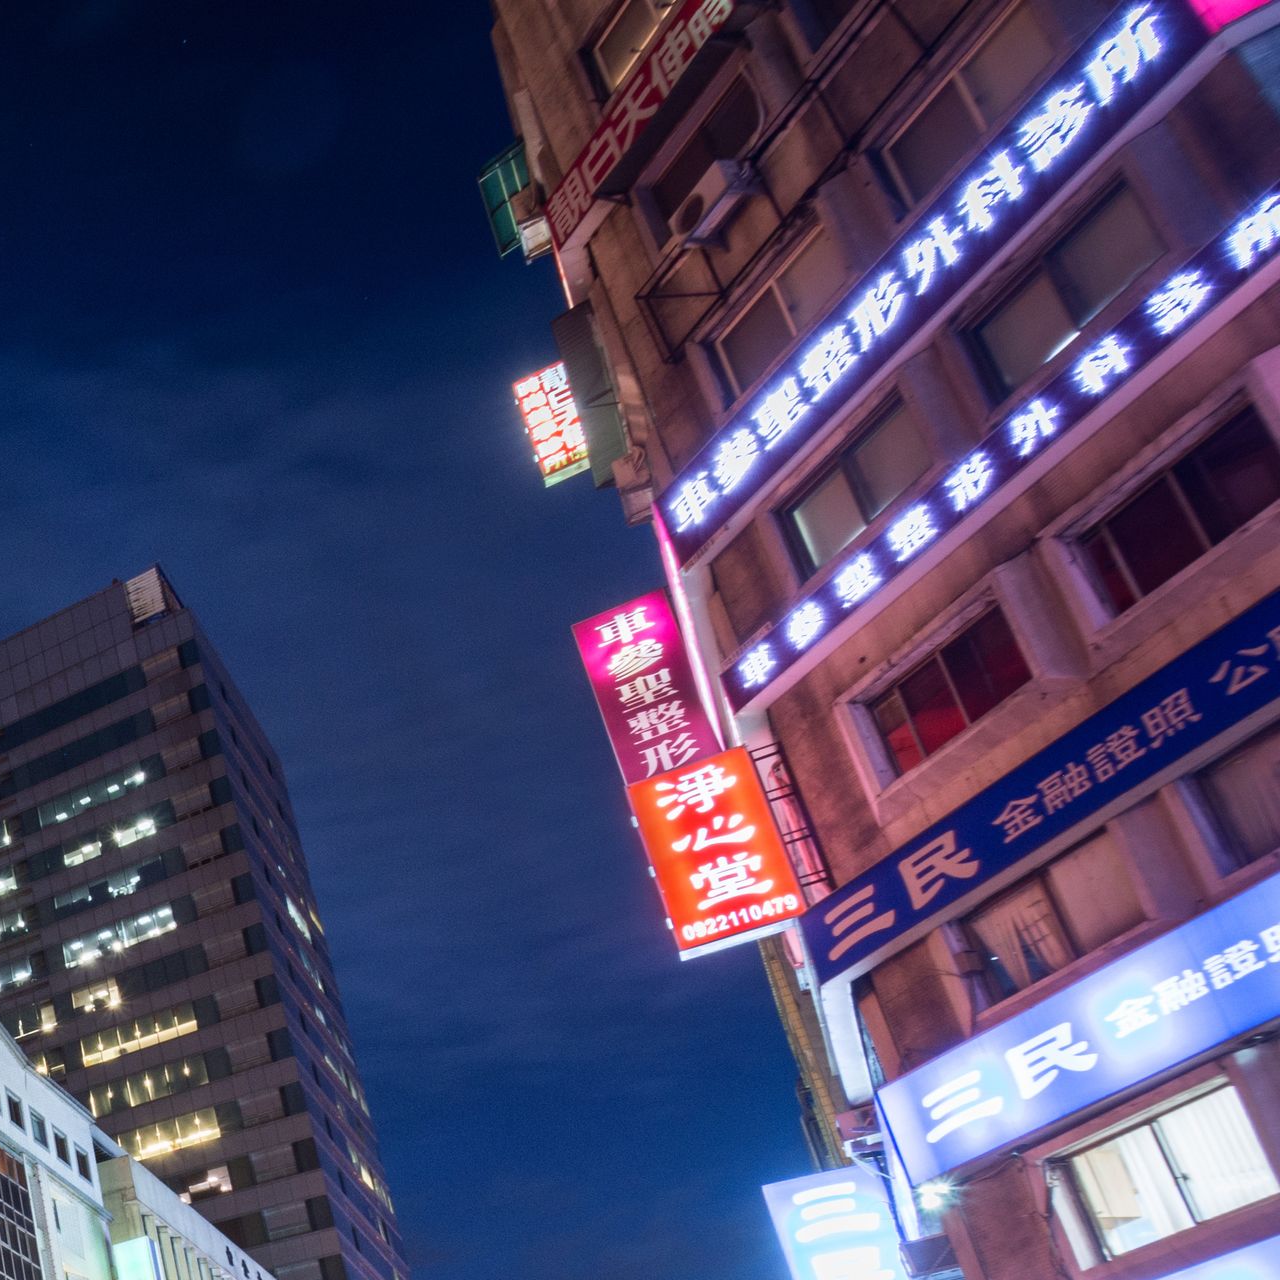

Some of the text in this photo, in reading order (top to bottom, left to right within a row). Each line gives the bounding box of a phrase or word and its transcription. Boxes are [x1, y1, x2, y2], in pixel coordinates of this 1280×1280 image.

[595, 607, 701, 778] 車參聖整形
[655, 764, 774, 910] 淨心堂
[824, 626, 1280, 960] 三民 金融證照 公
[682, 895, 798, 941] 0922110479
[922, 1022, 1098, 1143] 三民
